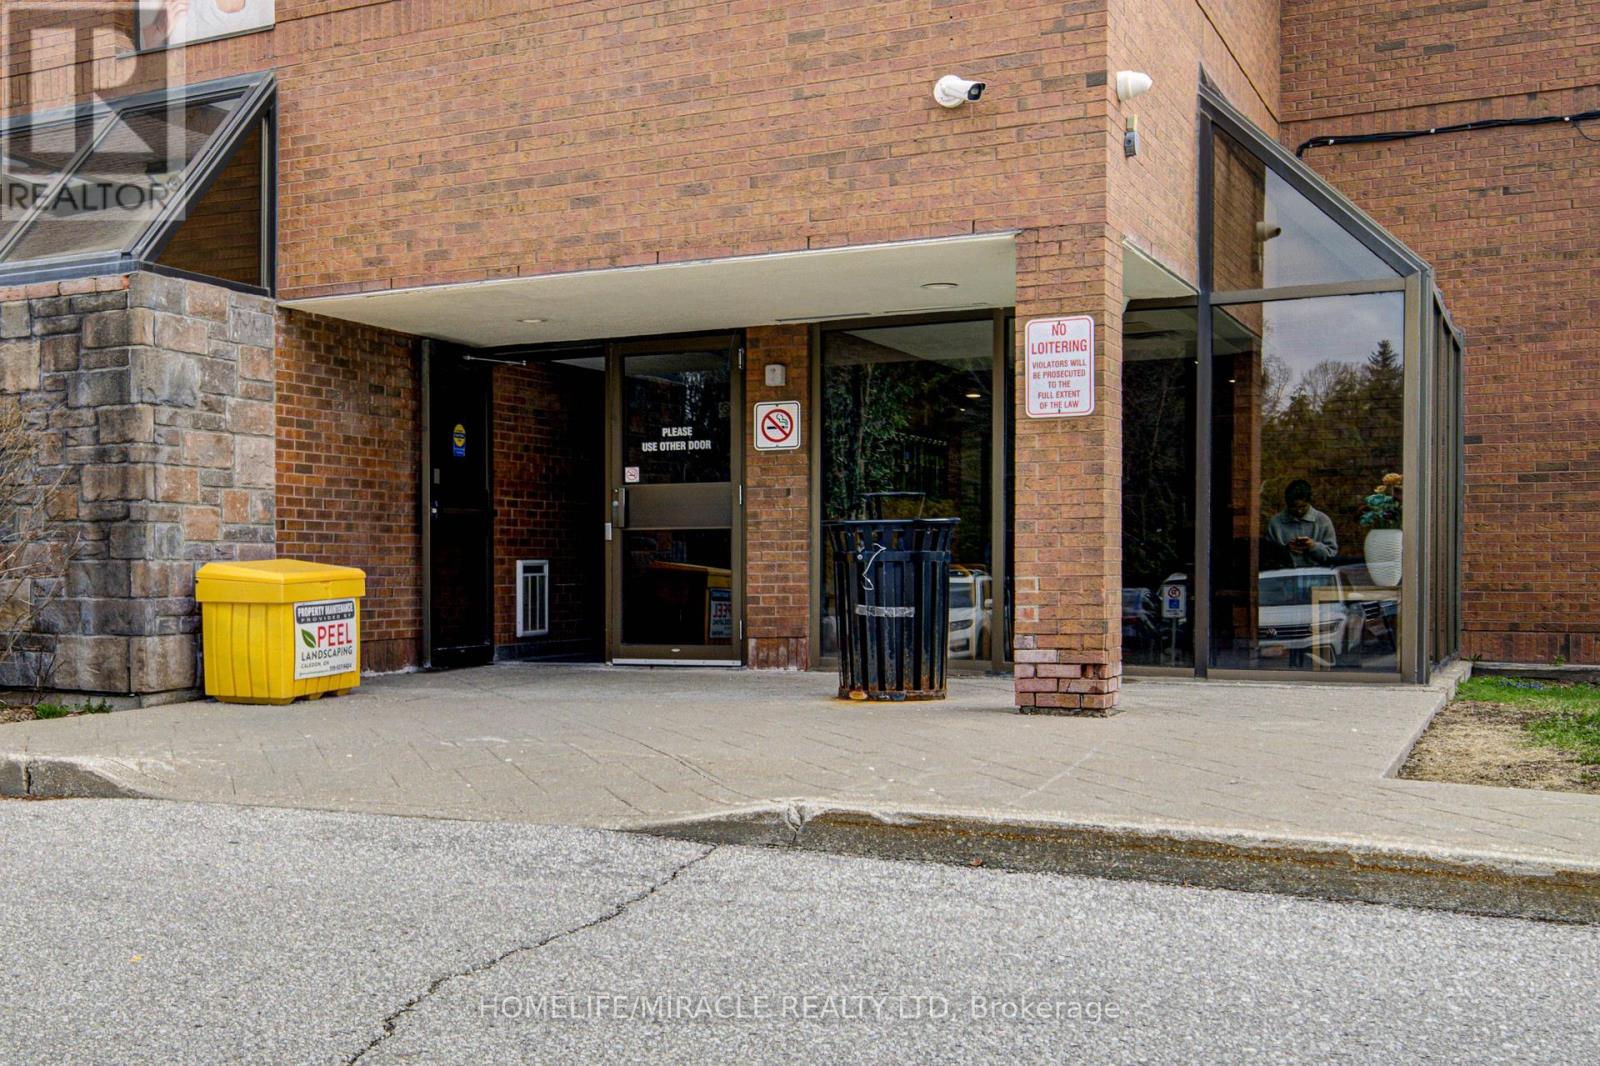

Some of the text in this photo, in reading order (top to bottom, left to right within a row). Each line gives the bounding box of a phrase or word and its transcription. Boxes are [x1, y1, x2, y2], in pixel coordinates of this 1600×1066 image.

[1051, 324, 1067, 336] NO
[1032, 339, 1088, 355] LOITERING
[1032, 359, 1087, 369] VIOLATORS WILL
[1033, 369, 1086, 380] BE PROSECUTED
[1048, 380, 1071, 389] TO THE
[1038, 390, 1081, 400] FULL EXTENT
[1040, 400, 1080, 410] OF THE LAW
[662, 427, 693, 437] PLEASE
[642, 440, 712, 452] USE OTHER DOOR
[298, 606, 324, 617] PROPERTY
[317, 623, 352, 648] PEEL
[301, 645, 353, 661] LANDSCAPING
